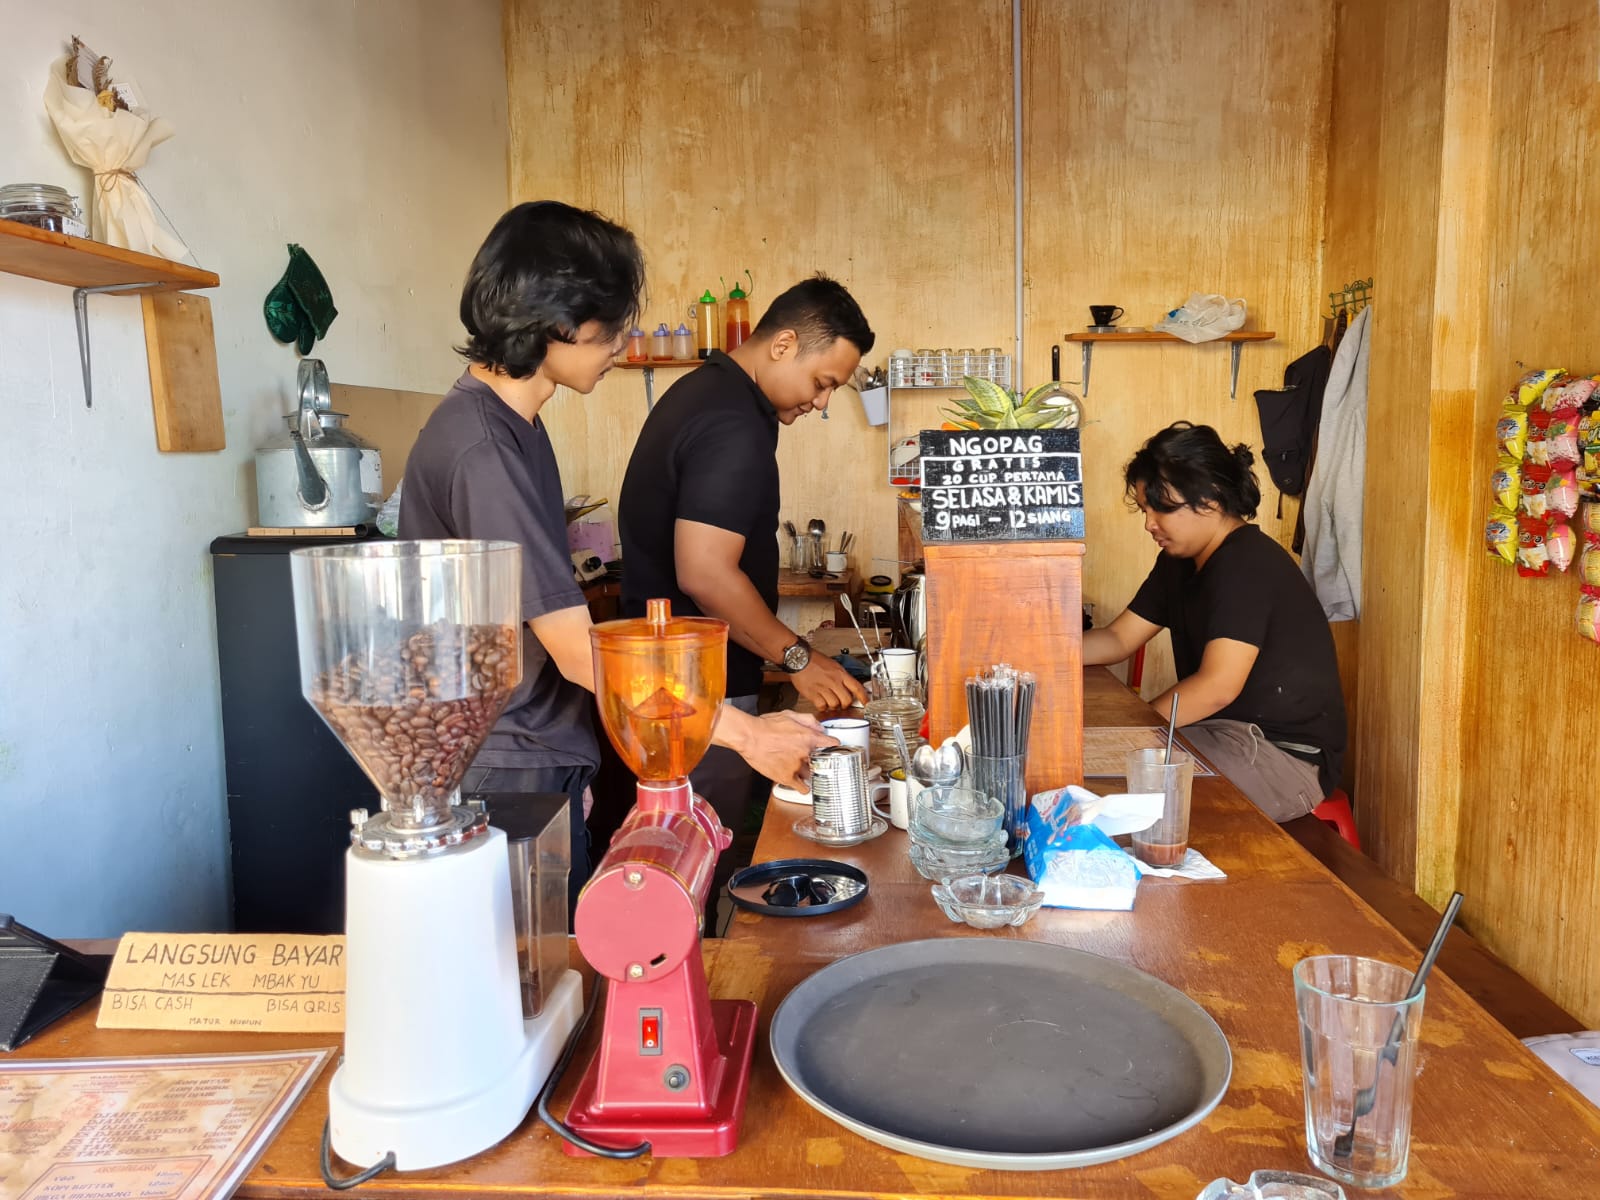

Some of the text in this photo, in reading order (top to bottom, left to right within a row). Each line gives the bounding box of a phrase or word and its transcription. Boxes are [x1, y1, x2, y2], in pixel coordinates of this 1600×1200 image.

[949, 435, 1043, 455] NGOPAG
[952, 457, 1041, 472] GRATIS
[942, 470, 1066, 485] 20 CUP PERTAMA
[931, 486, 1007, 509] SELASA
[1024, 485, 1081, 506] KAMIS
[934, 511, 950, 530] 9
[952, 514, 981, 528] PAGI
[1009, 510, 1027, 528] 12
[1027, 510, 1072, 524] SIANG
[126, 943, 344, 967] LANGSUNG BAYAR
[161, 972, 231, 988] MAS LEK
[252, 973, 320, 989] MBAK YU
[111, 994, 193, 1011] BISA CASH
[266, 998, 342, 1014] BISA QRIS
